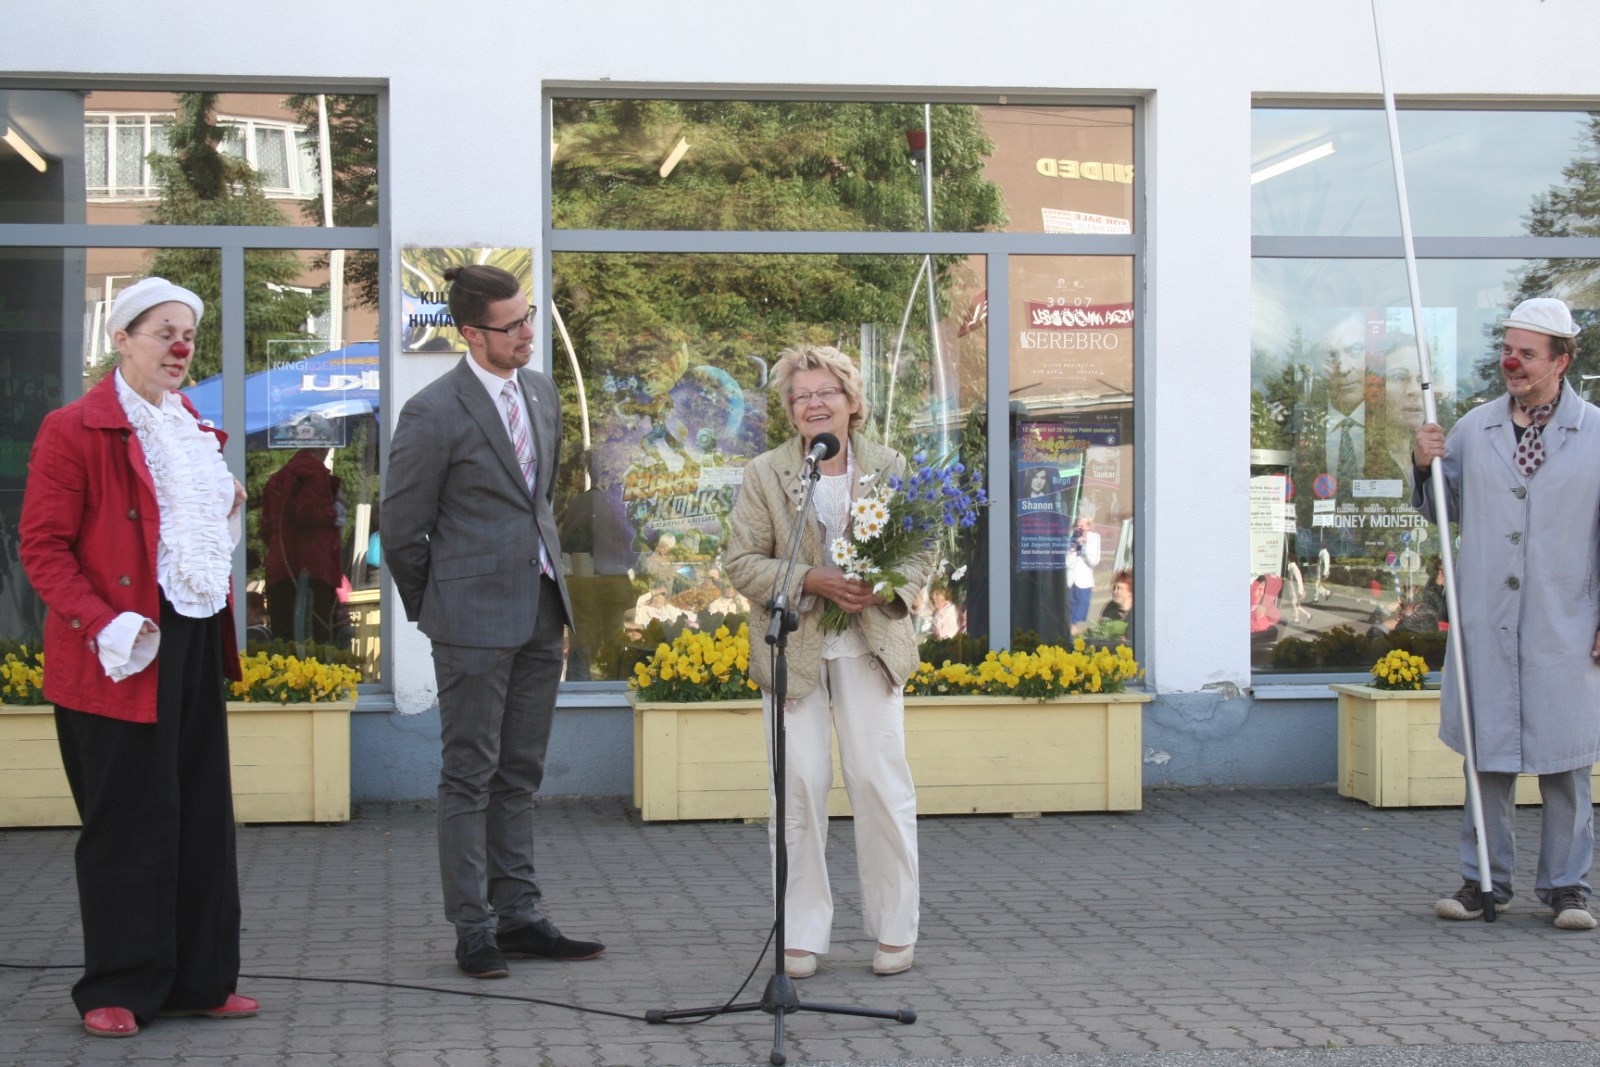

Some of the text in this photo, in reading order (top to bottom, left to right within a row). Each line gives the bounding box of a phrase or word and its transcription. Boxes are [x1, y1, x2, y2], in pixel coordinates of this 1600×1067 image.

[420, 291, 450, 305] KUL
[1046, 297, 1093, 308] 30 07
[409, 313, 458, 328] HUVIA
[1025, 331, 1119, 350] SEREBRO
[1092, 470, 1115, 479] Taukar
[1021, 500, 1053, 511] Shanon
[1370, 514, 1429, 528] MONSTER
